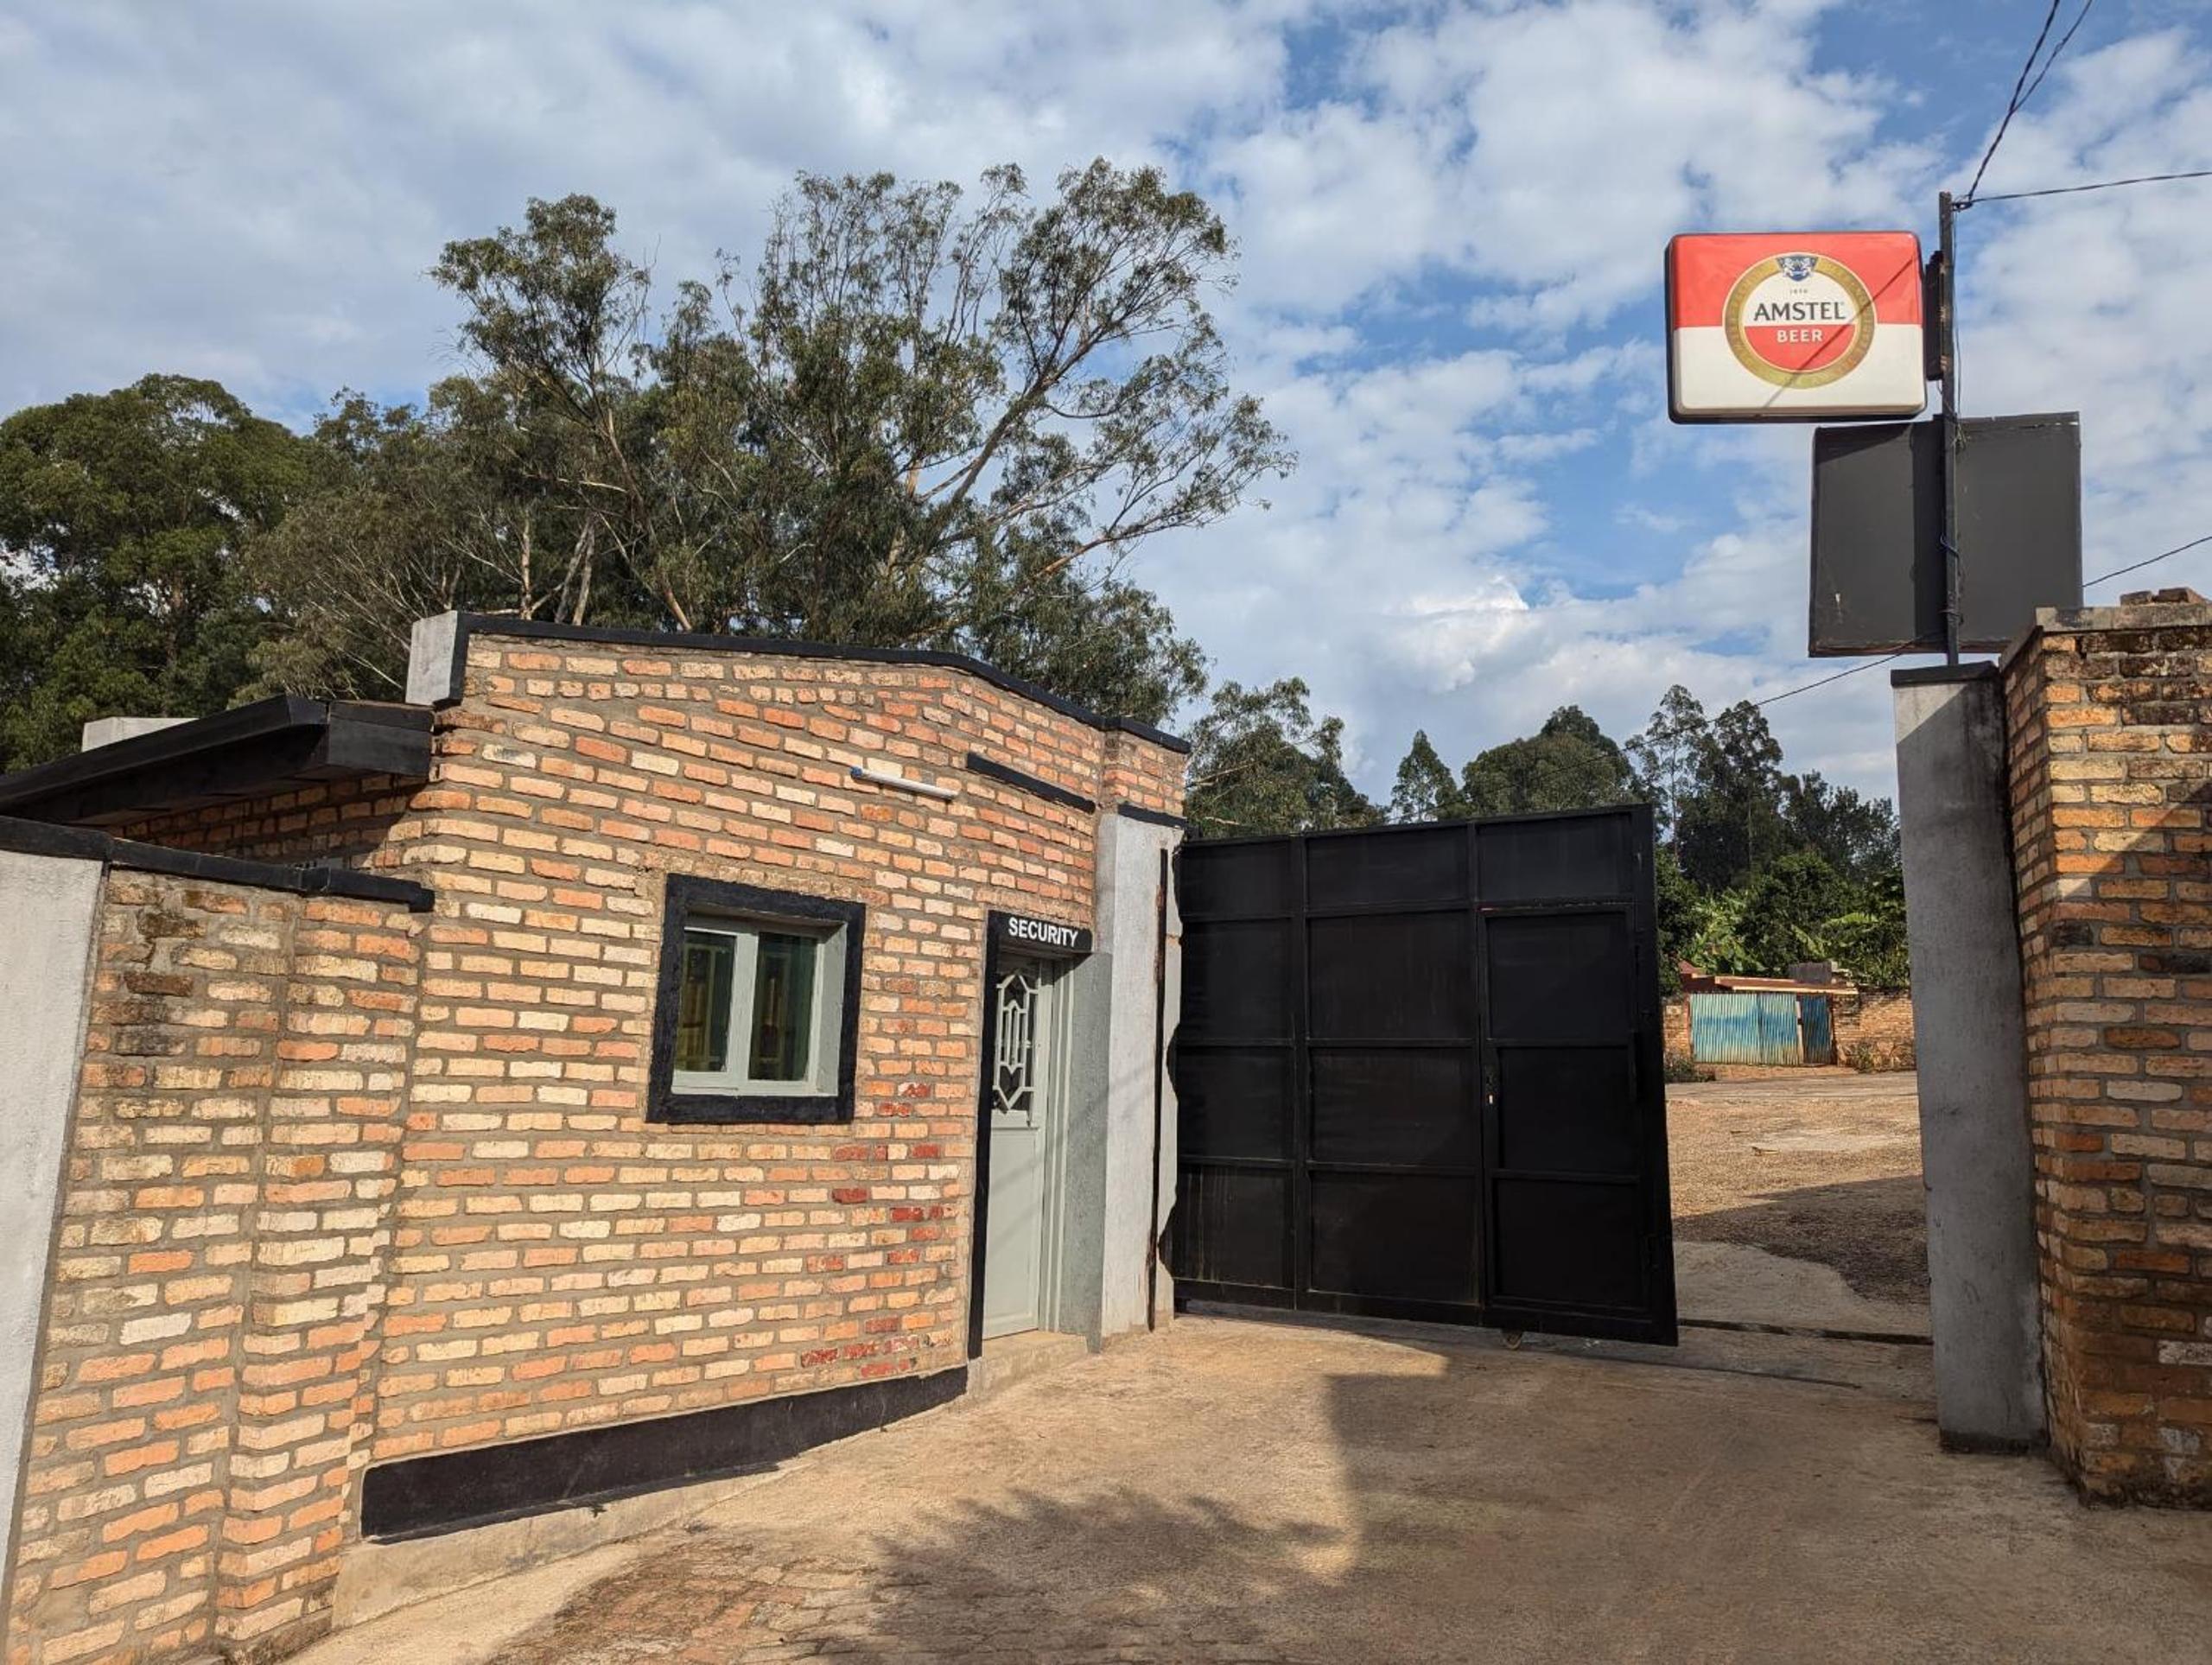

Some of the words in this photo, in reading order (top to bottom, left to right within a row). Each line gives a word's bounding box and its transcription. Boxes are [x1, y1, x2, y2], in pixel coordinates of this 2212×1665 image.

[1754, 302, 1846, 321] AMSTEL
[1777, 329, 1822, 343] BEER
[1008, 918, 1077, 947] SECURITY
